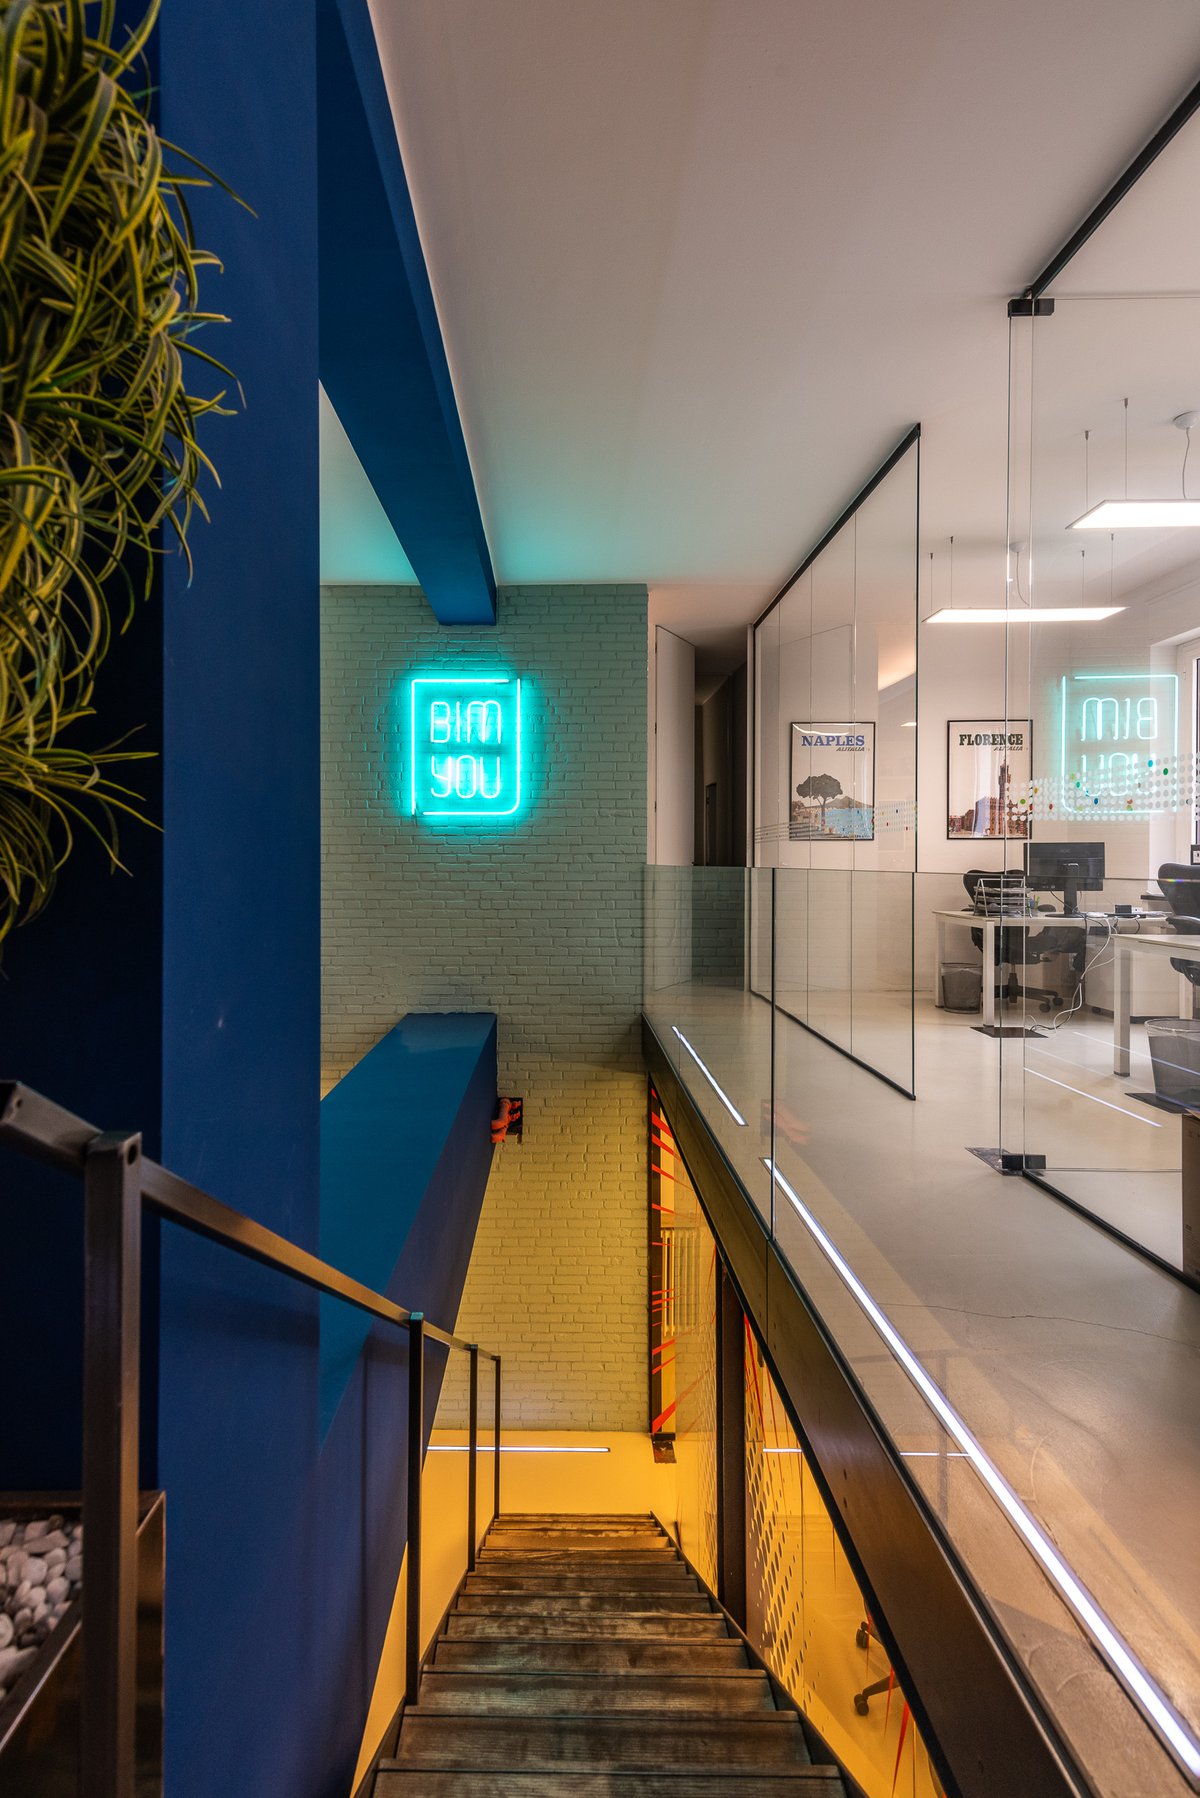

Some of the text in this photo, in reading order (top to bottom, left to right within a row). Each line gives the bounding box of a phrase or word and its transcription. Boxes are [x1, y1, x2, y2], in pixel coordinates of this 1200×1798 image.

[431, 700, 502, 744] BIM
[801, 735, 865, 747] NAPLES
[959, 733, 1023, 746] FLORENCE
[430, 755, 501, 799] YOU
